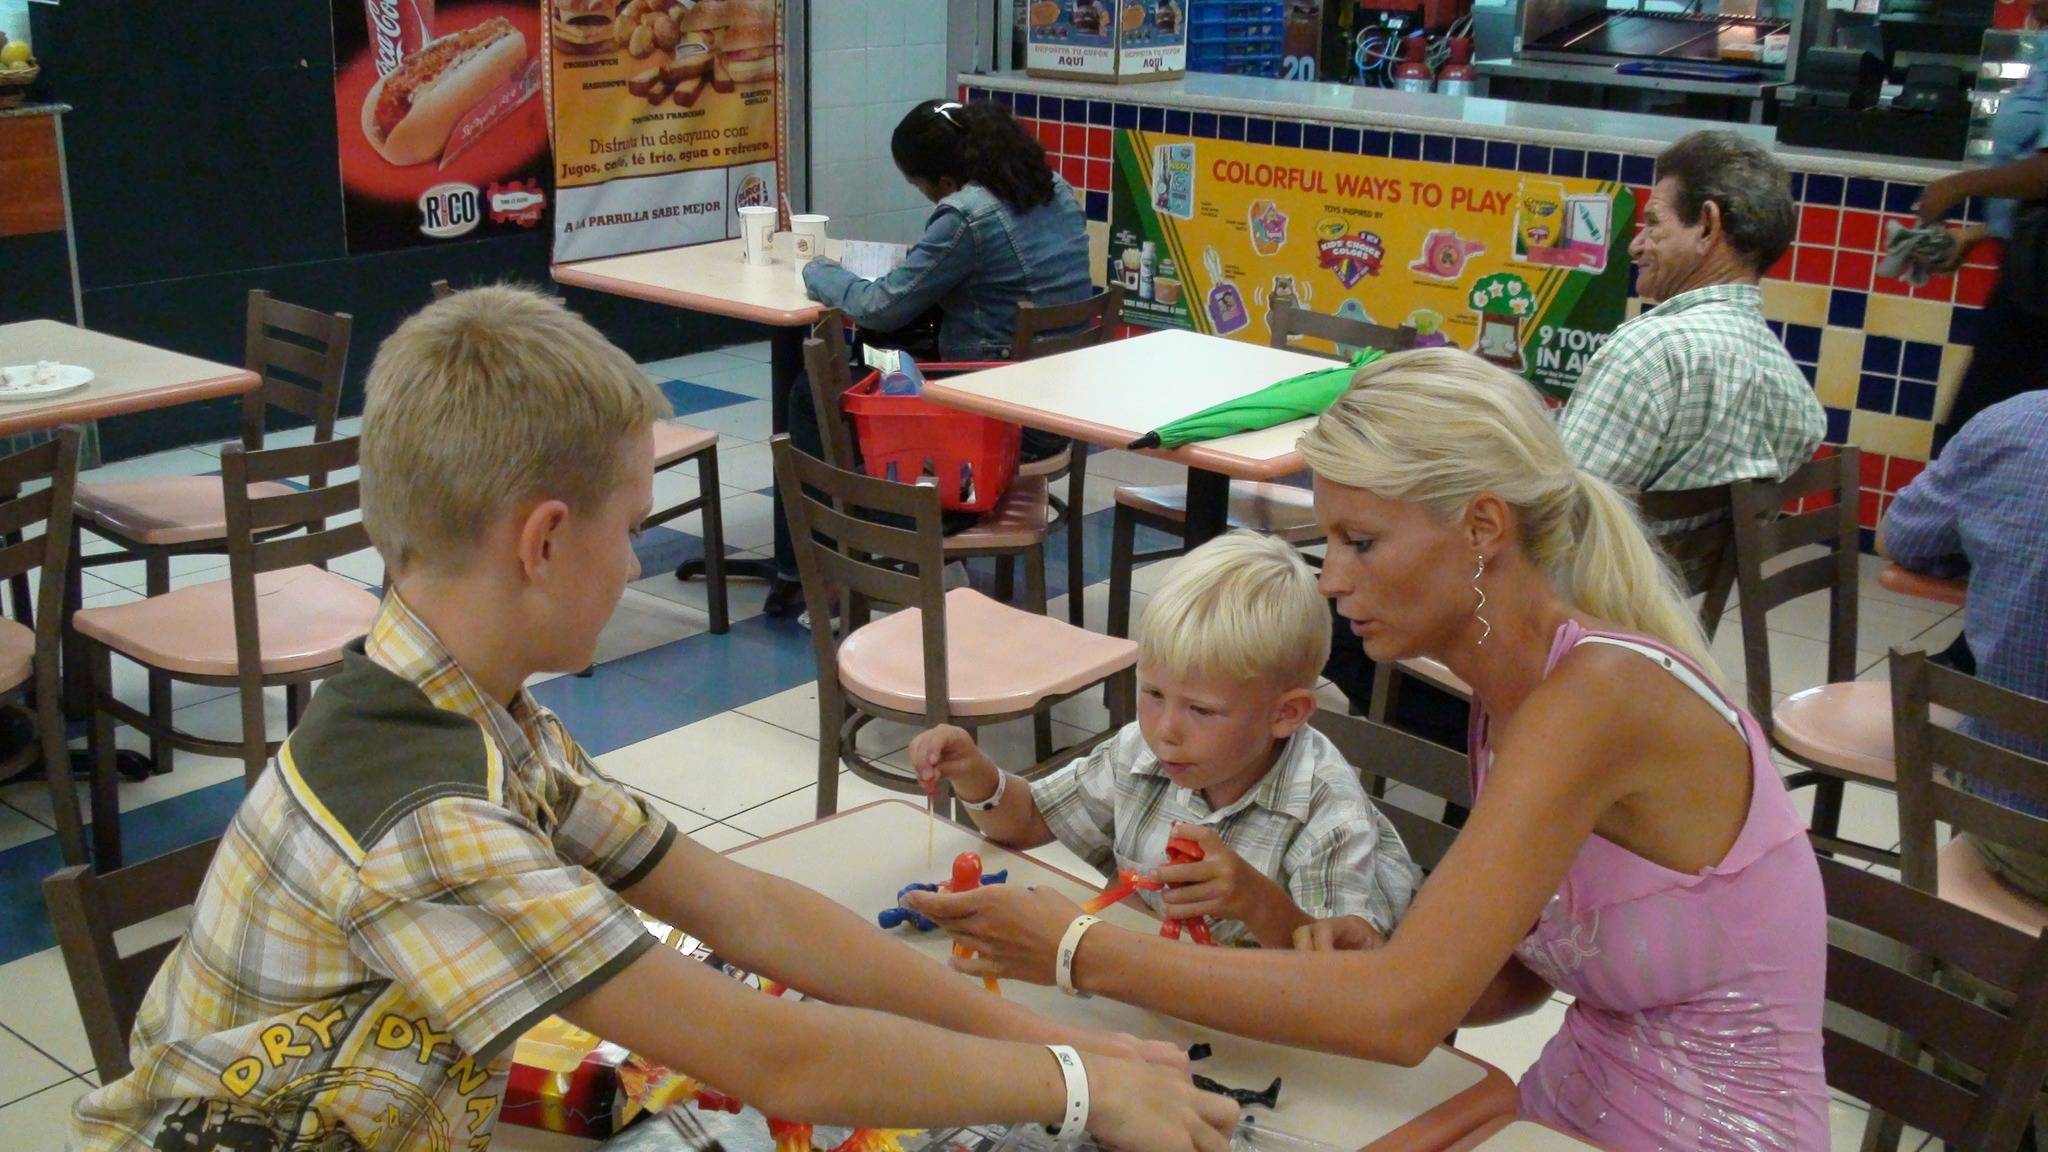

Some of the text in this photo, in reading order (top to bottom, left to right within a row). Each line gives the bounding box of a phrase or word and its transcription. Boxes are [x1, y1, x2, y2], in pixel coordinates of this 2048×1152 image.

[1283, 55, 1315, 81] 20
[641, 134, 655, 147] tu
[659, 127, 720, 147] desayuno
[561, 163, 600, 179] Jugos,
[632, 151, 645, 165] té
[679, 148, 708, 162] agua
[713, 147, 721, 157] o
[725, 141, 773, 156] refresco.
[1212, 159, 1328, 195] COLORFUL
[1336, 172, 1401, 204] WAYS
[1409, 182, 1442, 208] TO
[1451, 186, 1514, 216] PLAY
[426, 191, 475, 228] RICO
[564, 221, 573, 234] A
[588, 210, 649, 227] PARRILLA
[651, 208, 680, 220] SABE
[683, 201, 721, 216] MEJOR
[1539, 325, 1554, 345] 9
[1536, 347, 1561, 370] IN
[220, 1007, 345, 1098] DRY
